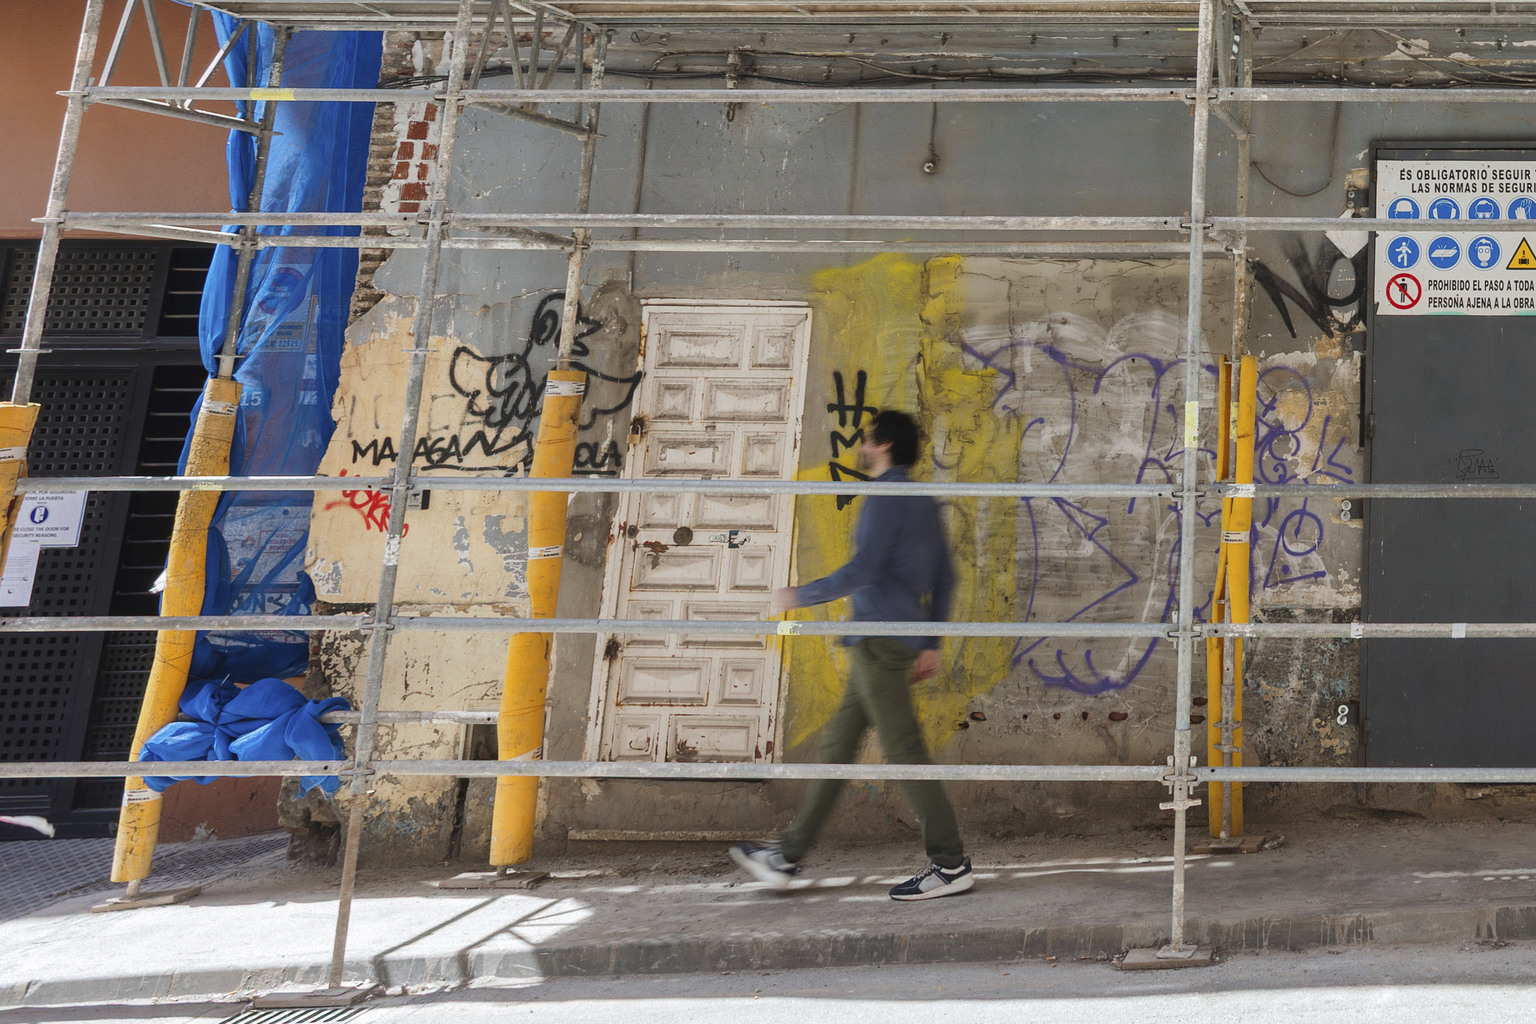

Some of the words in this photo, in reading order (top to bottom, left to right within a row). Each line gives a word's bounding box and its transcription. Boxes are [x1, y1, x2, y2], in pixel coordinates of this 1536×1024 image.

[1400, 169, 1413, 181] ES
[1416, 169, 1488, 181] OBLIGATORIO
[1491, 169, 1531, 181] SEGUIR
[1411, 183, 1431, 193] LAS
[1434, 182, 1478, 193] NORMAS
[1481, 182, 1495, 193] DE
[1428, 279, 1470, 291] PROHIBIDO
[1473, 280, 1483, 291] EL
[1484, 280, 1505, 291] PASO
[1507, 280, 1512, 291] A
[1514, 280, 1535, 291] TODA
[1428, 297, 1464, 308] PERSONA
[1466, 297, 1493, 309] AJENA
[1494, 297, 1500, 308] A
[1502, 297, 1511, 308] LA
[1513, 297, 1535, 308] OBRA
